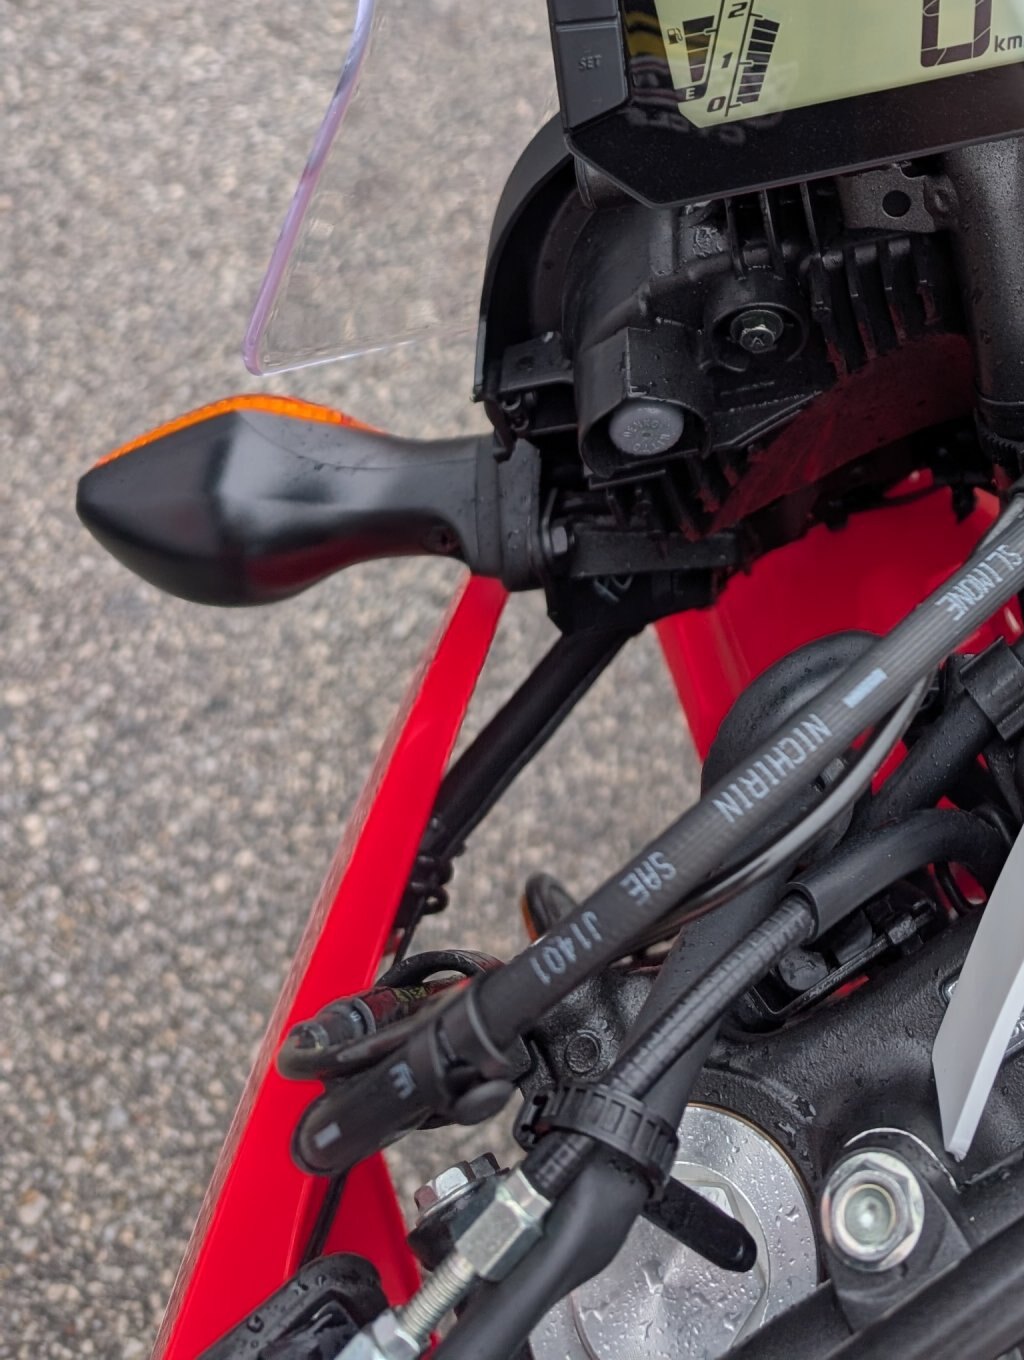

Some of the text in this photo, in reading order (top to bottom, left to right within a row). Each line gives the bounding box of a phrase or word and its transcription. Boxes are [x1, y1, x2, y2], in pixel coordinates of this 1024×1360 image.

[728, 2, 749, 17] 2
[578, 54, 602, 71] SET
[720, 53, 732, 69] 1
[685, 87, 696, 99] E
[706, 96, 726, 113] 0
[935, 542, 1024, 622] SLIMONE
[530, 712, 835, 986] NICHIRIN SAE J1401
